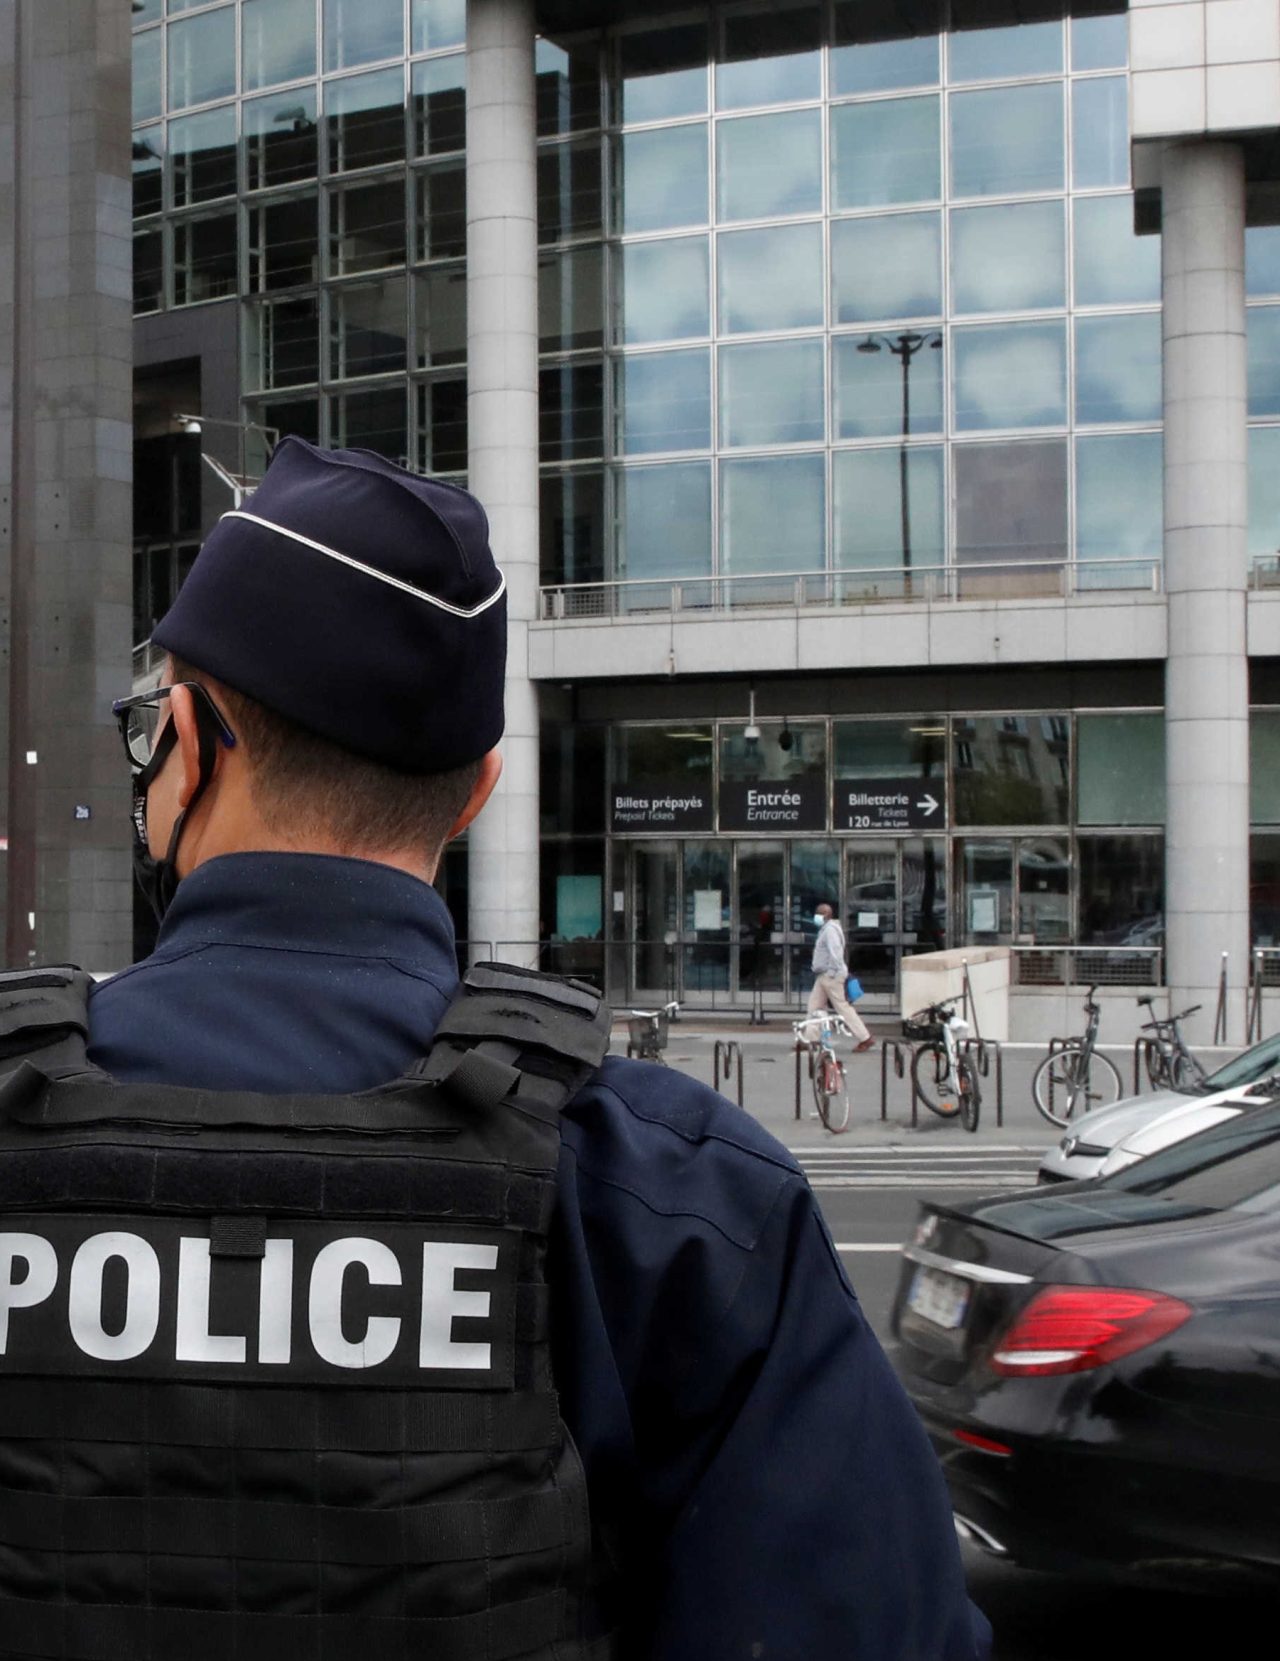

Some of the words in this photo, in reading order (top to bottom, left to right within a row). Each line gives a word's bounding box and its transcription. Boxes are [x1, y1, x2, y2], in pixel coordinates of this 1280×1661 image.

[616, 796, 649, 809] Billets
[652, 796, 703, 811] prépayés
[747, 789, 801, 806] Entrée
[848, 793, 909, 806] Billetterie
[615, 810, 646, 822] Prepaid
[648, 810, 675, 821] Tickets
[747, 807, 799, 821] Entrance
[877, 807, 908, 818] Tickets
[848, 816, 870, 828] 120
